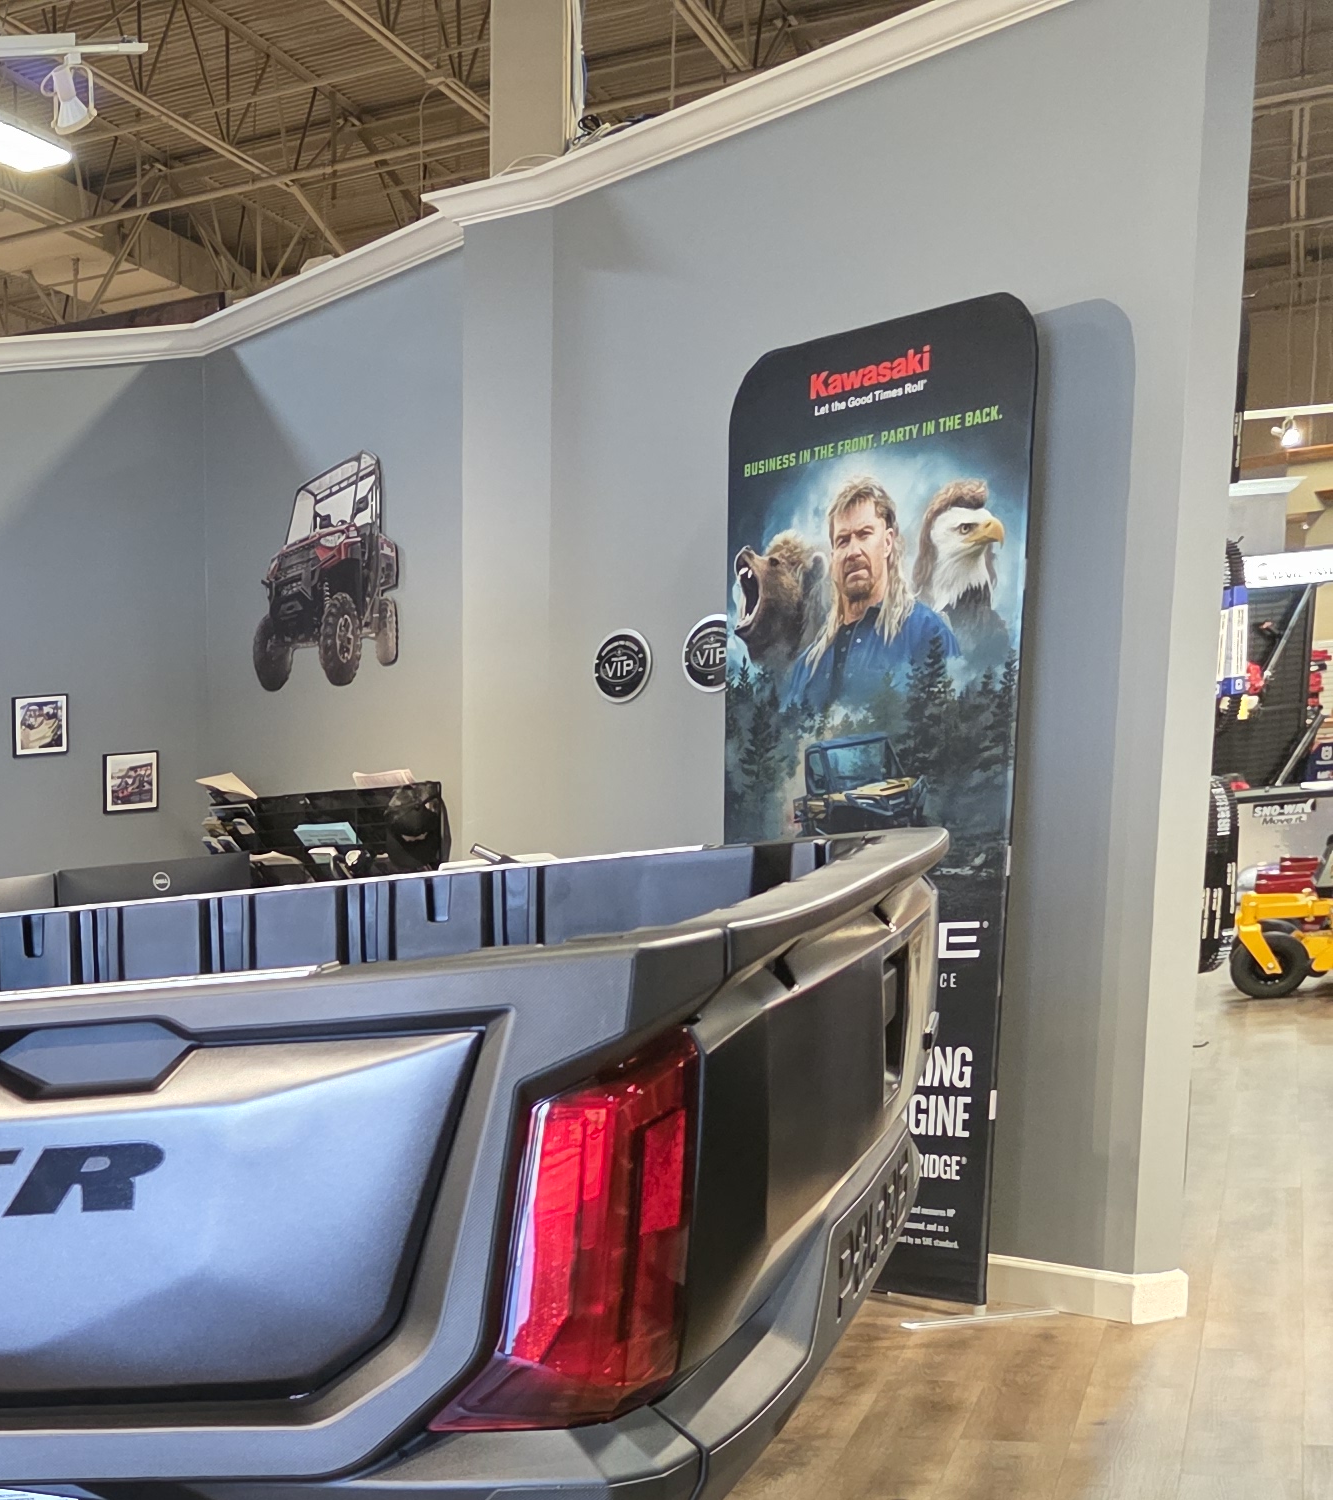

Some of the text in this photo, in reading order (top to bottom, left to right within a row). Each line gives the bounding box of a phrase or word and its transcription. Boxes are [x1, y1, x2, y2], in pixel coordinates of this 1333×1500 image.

[809, 344, 932, 400] Kawasaki
[814, 403, 830, 417] Let
[831, 398, 846, 414] the
[847, 392, 873, 409] Good
[874, 386, 903, 402] Times
[744, 404, 1003, 478] BUSINESS IN THE FRONT. PARTY IN THE BACK.
[605, 660, 633, 677] VIP
[696, 648, 727, 666] VIP
[917, 1046, 974, 1089] ING
[902, 1094, 973, 1138] GINE
